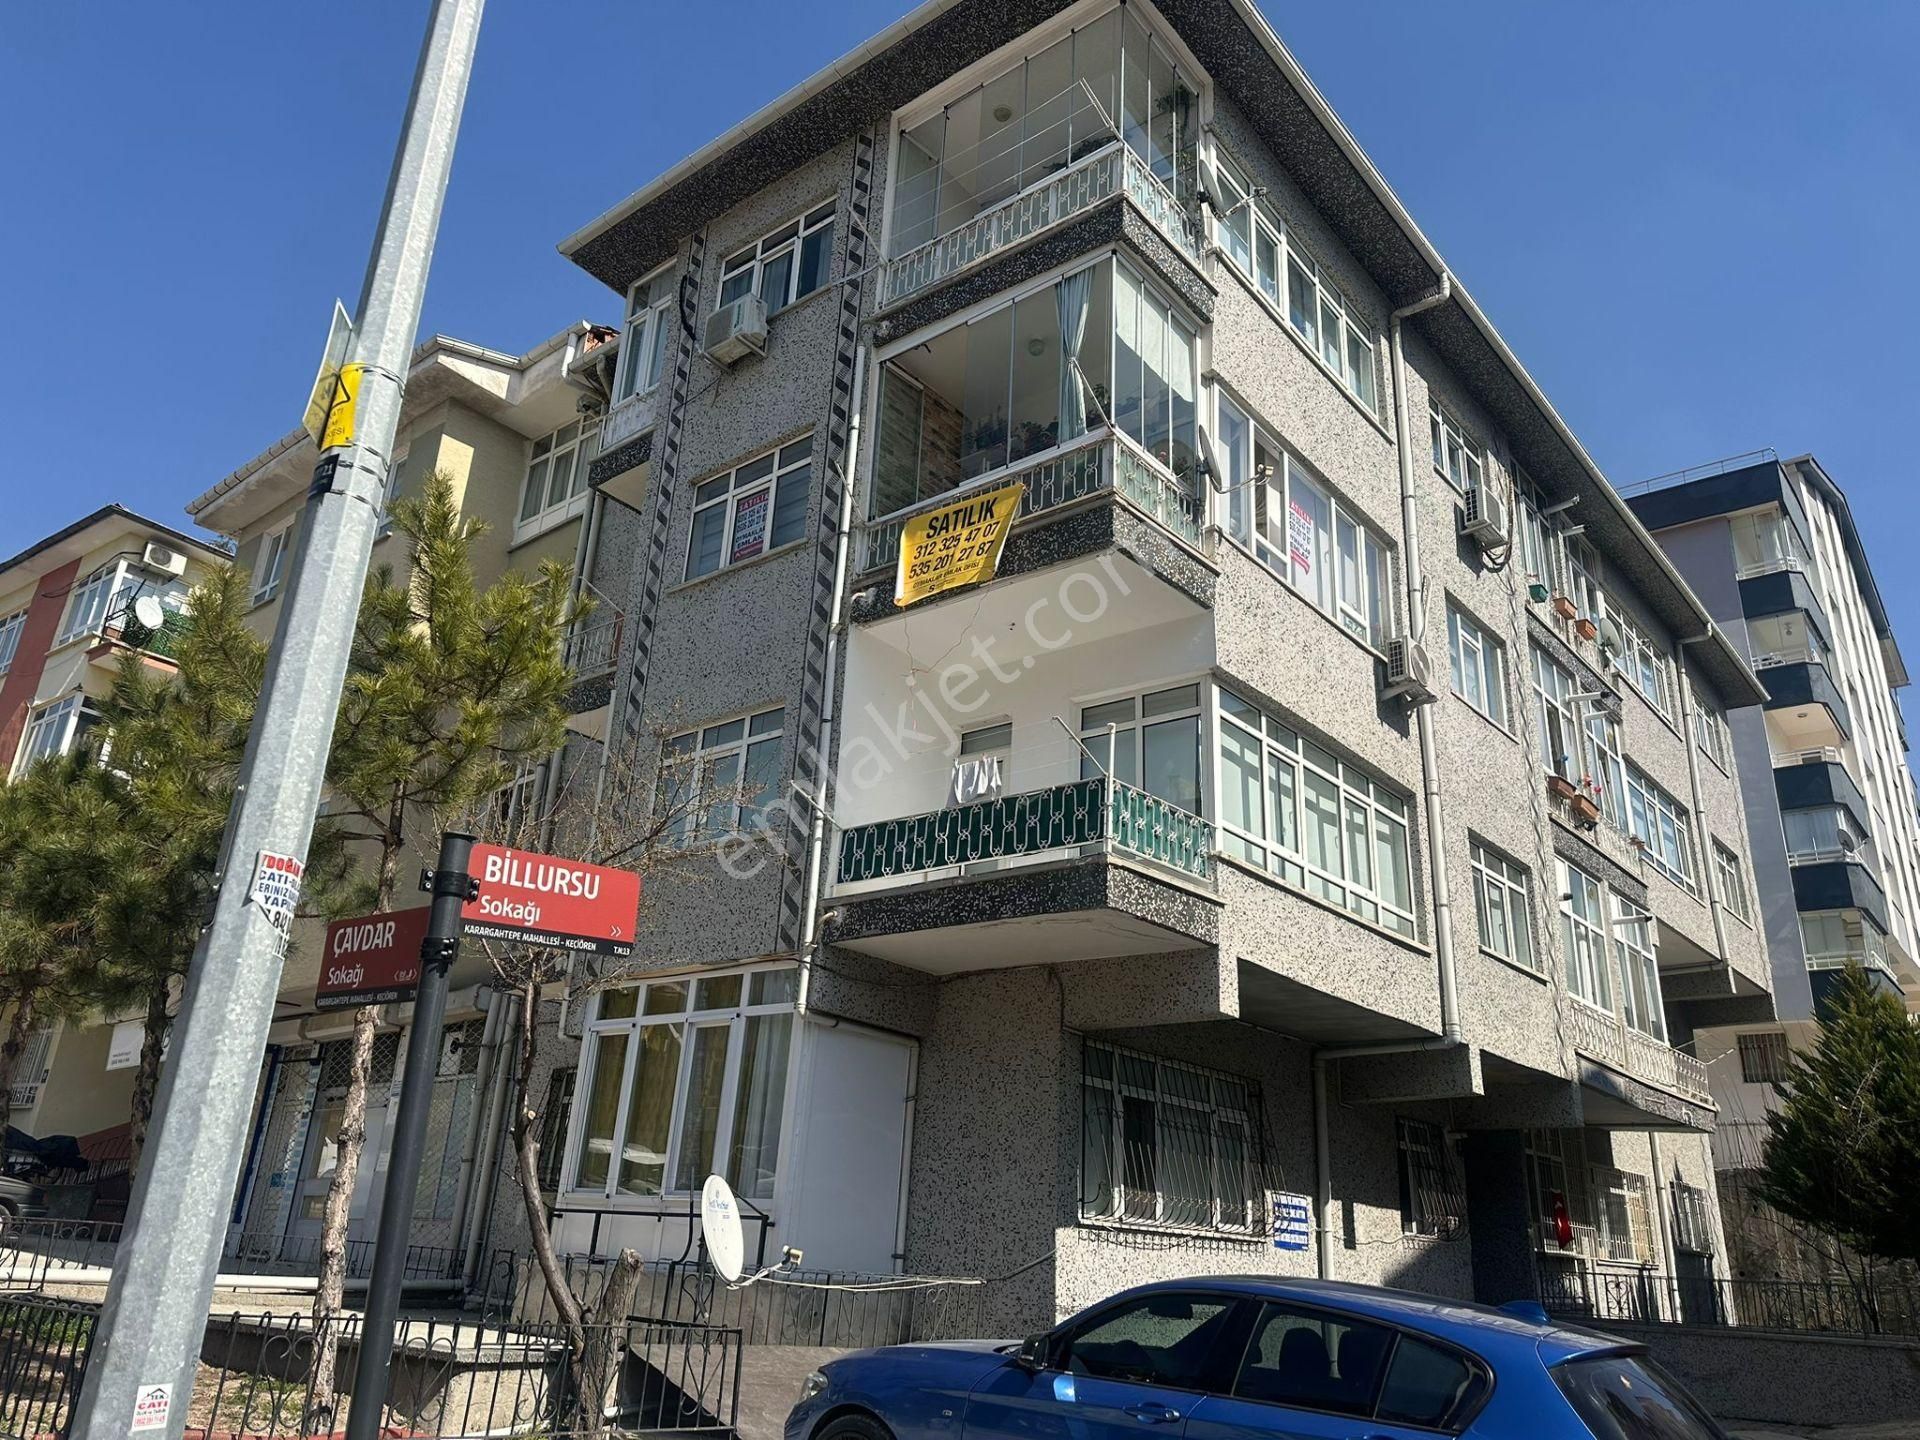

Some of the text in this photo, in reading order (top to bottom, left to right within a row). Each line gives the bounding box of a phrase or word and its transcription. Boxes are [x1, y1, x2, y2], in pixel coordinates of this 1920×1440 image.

[926, 497, 997, 539] SATILIK
[908, 540, 994, 579] 535 201 27 87
[914, 522, 999, 560] 312 325 47 07
[484, 850, 600, 900] BİLLURSU
[480, 895, 540, 926] Sokağı
[333, 921, 395, 958] ÇAVDAR
[464, 924, 521, 940] KARARGAHTEPE
[522, 933, 559, 945] MAHALLESİ
[565, 938, 596, 951] KEÇİÖREN
[327, 963, 364, 988] Sokağı
